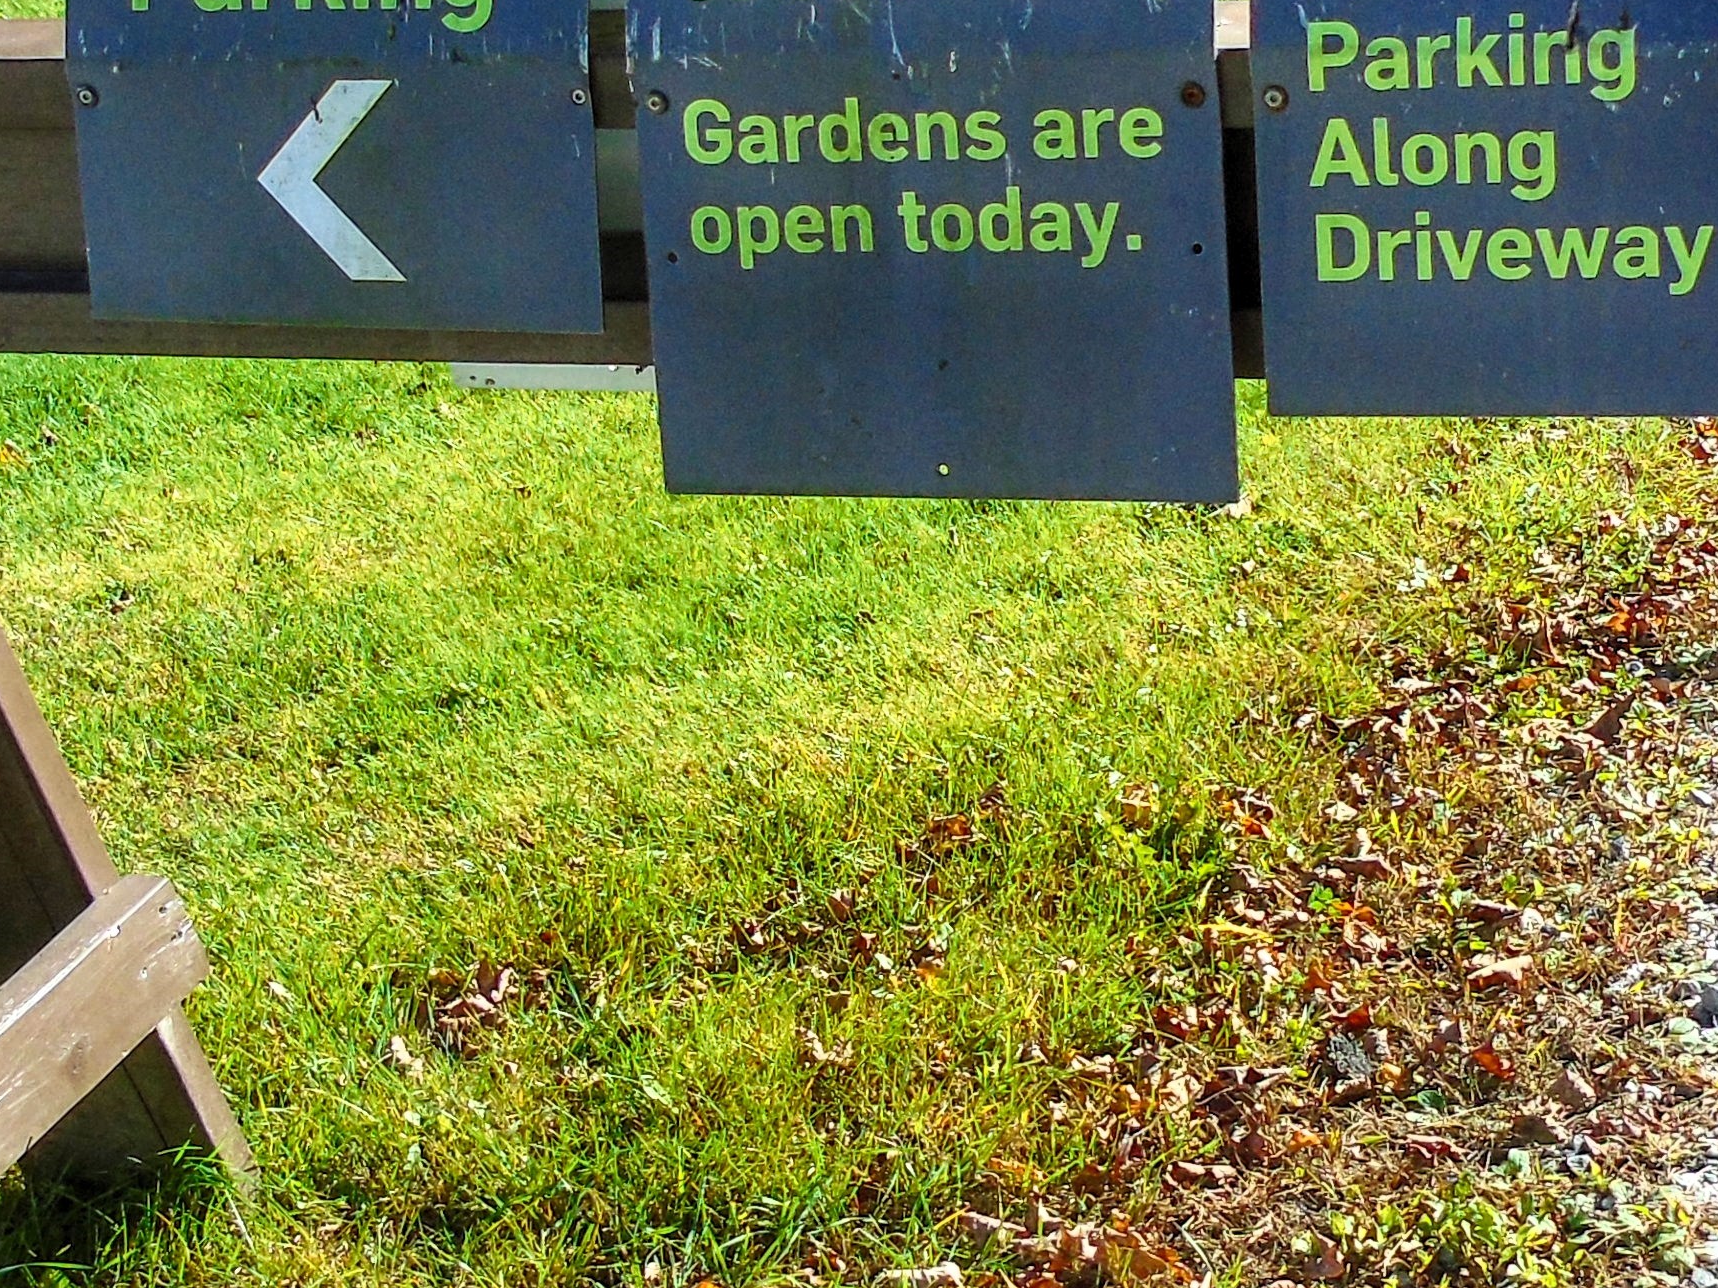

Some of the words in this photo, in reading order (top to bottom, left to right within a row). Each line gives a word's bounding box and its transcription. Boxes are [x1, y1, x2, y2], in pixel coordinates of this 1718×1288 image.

[1304, 12, 1639, 102] Parking
[682, 96, 1007, 165] Gardens
[1030, 106, 1166, 159] are
[1309, 116, 1560, 202] Along
[689, 200, 877, 271] open
[897, 184, 1144, 270] today.
[1313, 211, 1716, 296] Driveway
